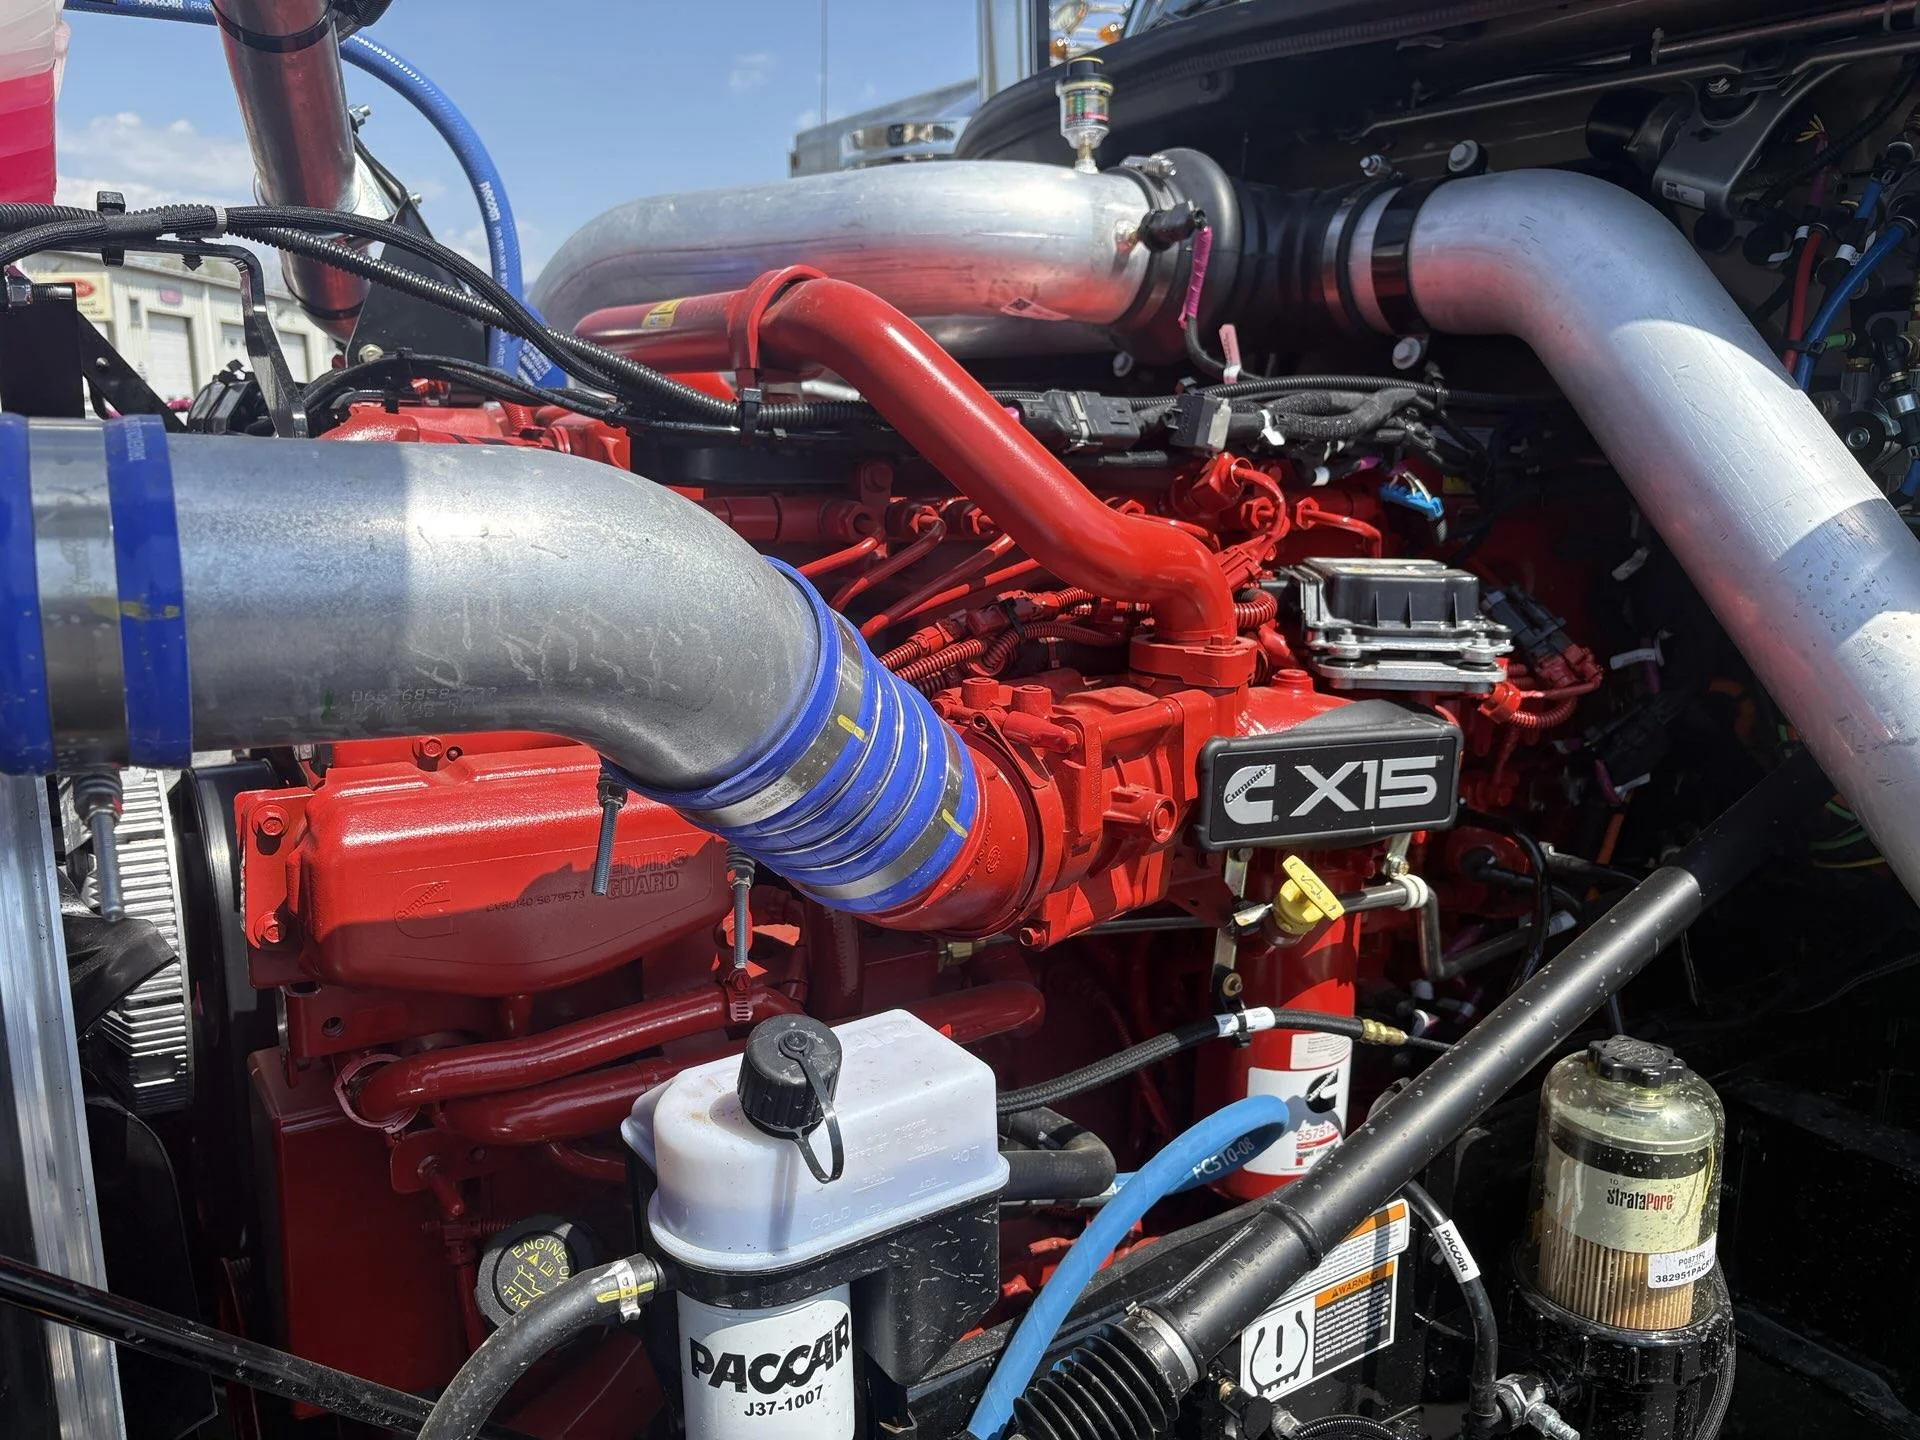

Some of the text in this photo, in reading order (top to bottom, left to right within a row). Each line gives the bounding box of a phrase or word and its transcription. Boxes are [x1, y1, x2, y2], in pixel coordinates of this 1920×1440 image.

[1224, 764, 1272, 804] Cummins
[1289, 756, 1438, 817] X15
[607, 870, 680, 900] GUARD
[512, 1238, 568, 1263] ENGINE
[1441, 1228, 1469, 1273] PACCAR
[1336, 1270, 1379, 1297] WARNING
[689, 1312, 851, 1394] PACCAR
[743, 1384, 824, 1417] J37-1007
